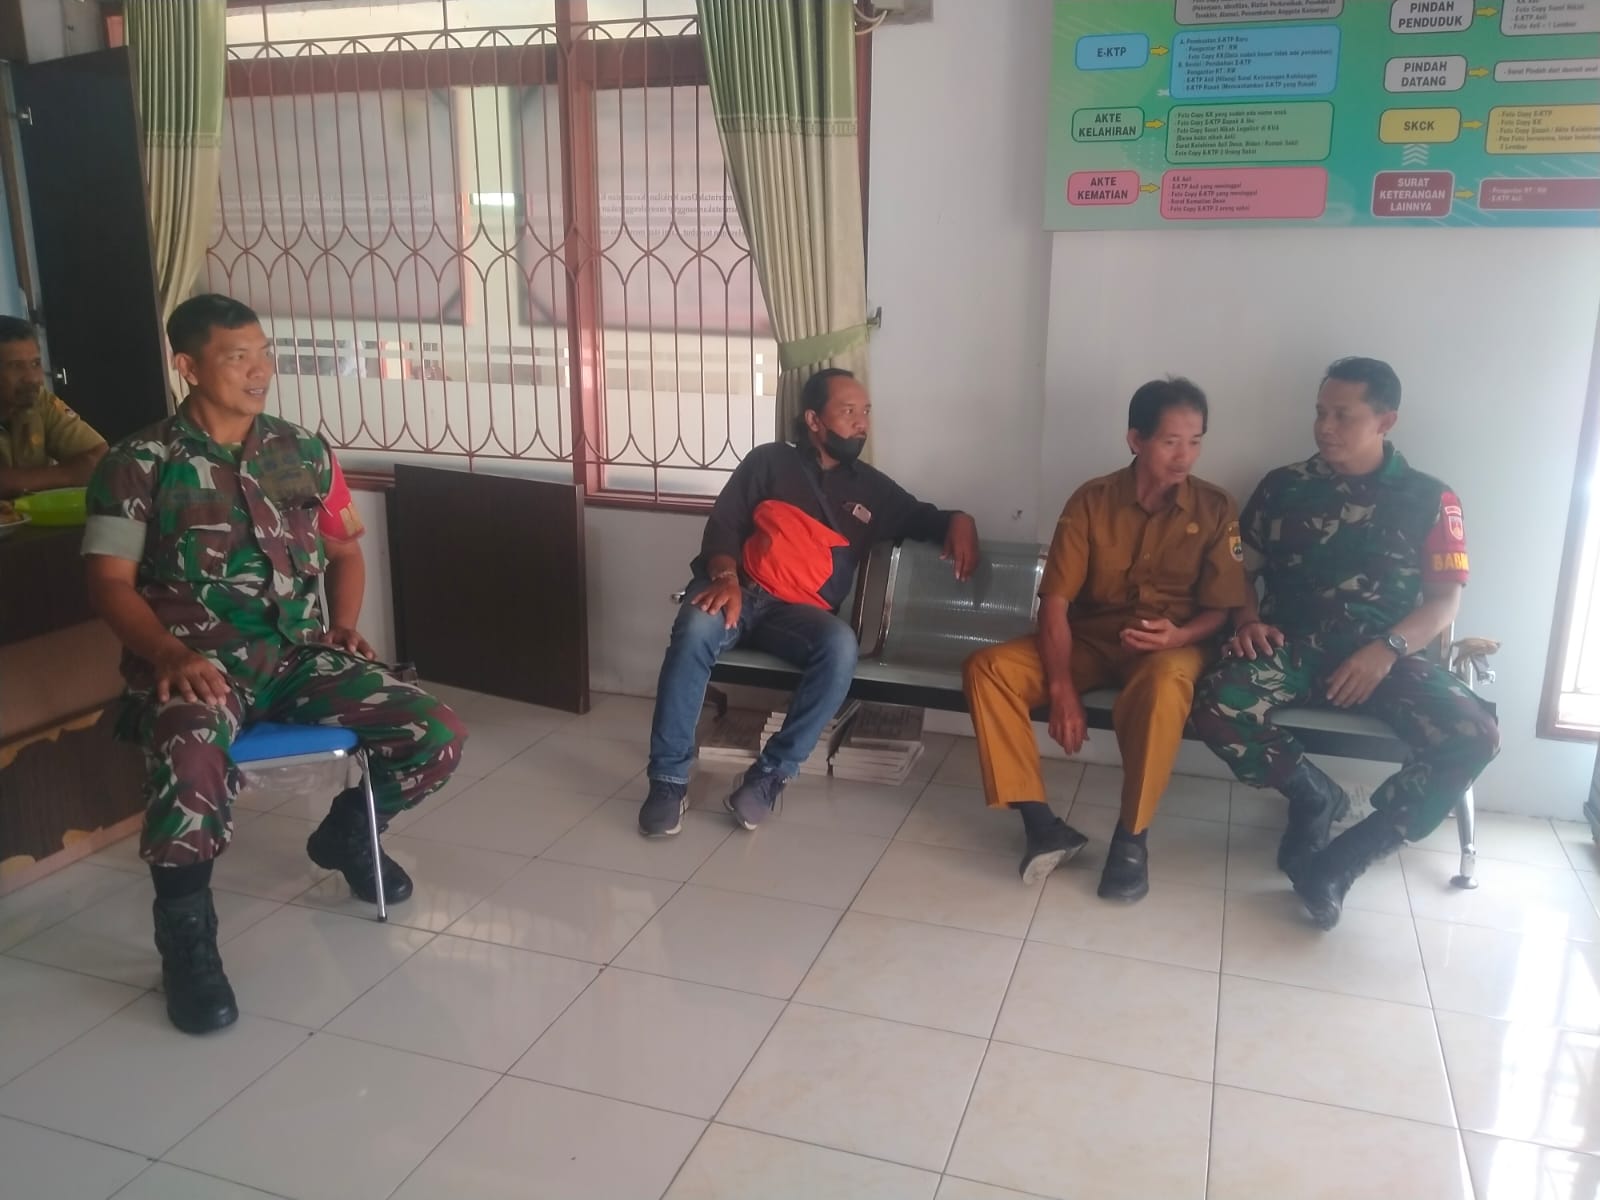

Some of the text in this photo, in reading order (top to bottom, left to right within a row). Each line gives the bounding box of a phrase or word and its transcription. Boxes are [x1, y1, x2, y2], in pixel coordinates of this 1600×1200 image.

[1410, 1, 1455, 13] PINDAH
[1398, 15, 1463, 28] PENDUDUK
[1097, 47, 1127, 58] E-KTP
[1404, 61, 1447, 73] PINDAH
[1401, 75, 1447, 87] DATANG
[1095, 112, 1122, 123] AKTE
[1078, 125, 1136, 137] KELAHIRAN
[1403, 120, 1435, 131] SKCK
[1090, 176, 1117, 187] AKTE
[1398, 177, 1431, 187] SURAT
[1077, 188, 1128, 201] KEMATIAN
[1380, 189, 1446, 200] KETERANGAN
[1390, 201, 1432, 212] LAINNYA
